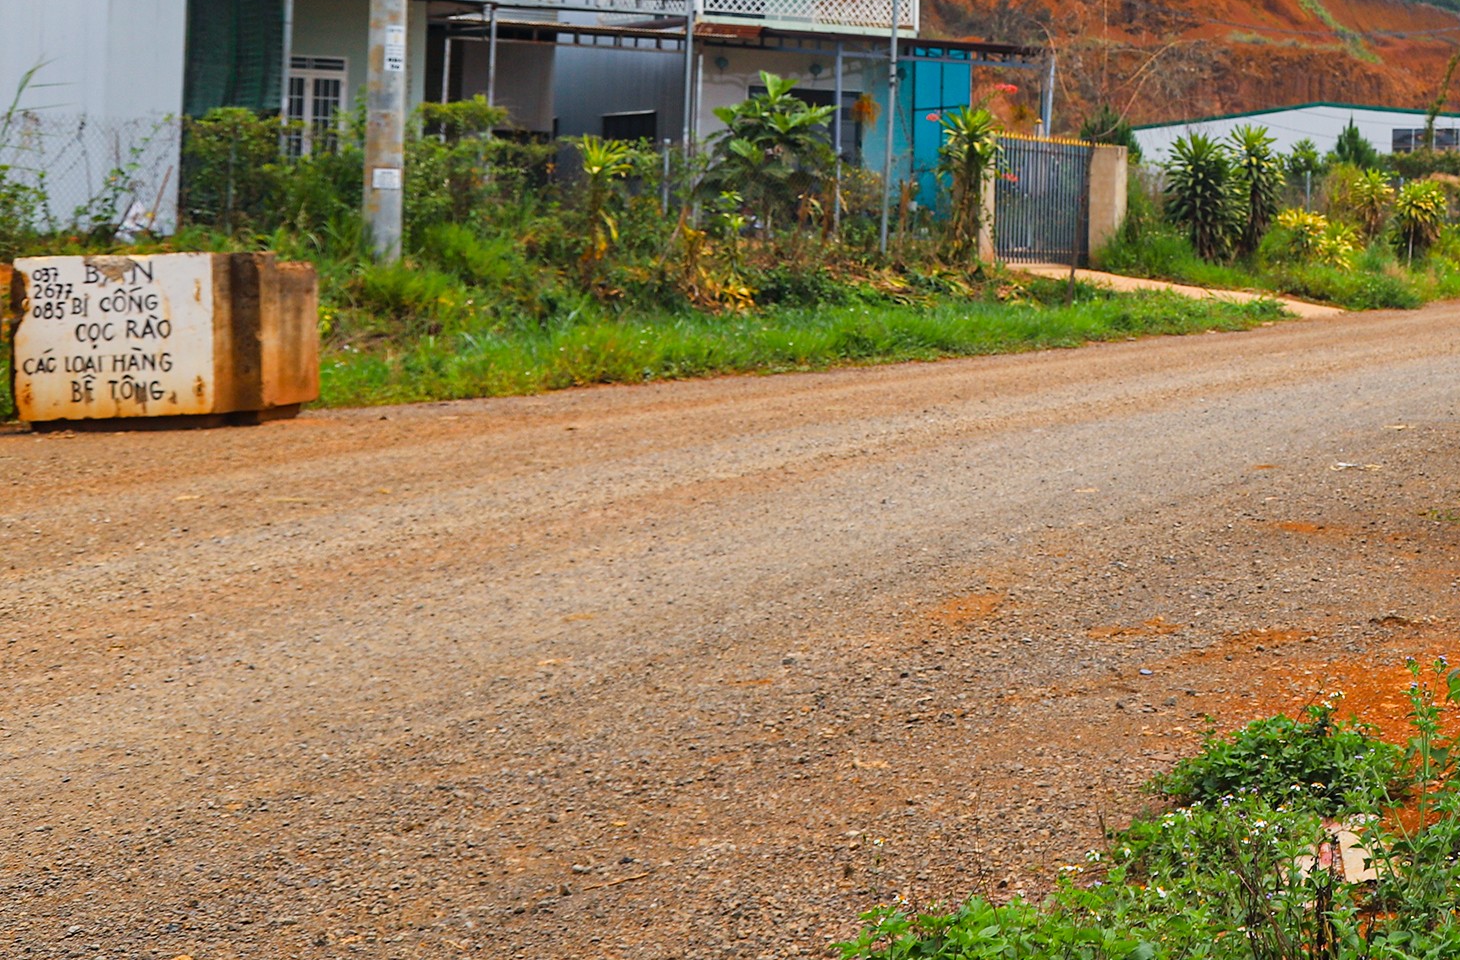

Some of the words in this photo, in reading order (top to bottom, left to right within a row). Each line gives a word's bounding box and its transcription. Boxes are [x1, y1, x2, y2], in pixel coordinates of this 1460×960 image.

[32, 266, 58, 282] 037
[83, 260, 154, 287] BN
[34, 284, 73, 300] 2677
[33, 302, 66, 320] 085
[75, 322, 115, 349] CỌC
[126, 314, 172, 339] RÀO
[23, 348, 56, 375] CÁC
[112, 346, 173, 372] HÀNG
[108, 374, 165, 403] TÔNG
